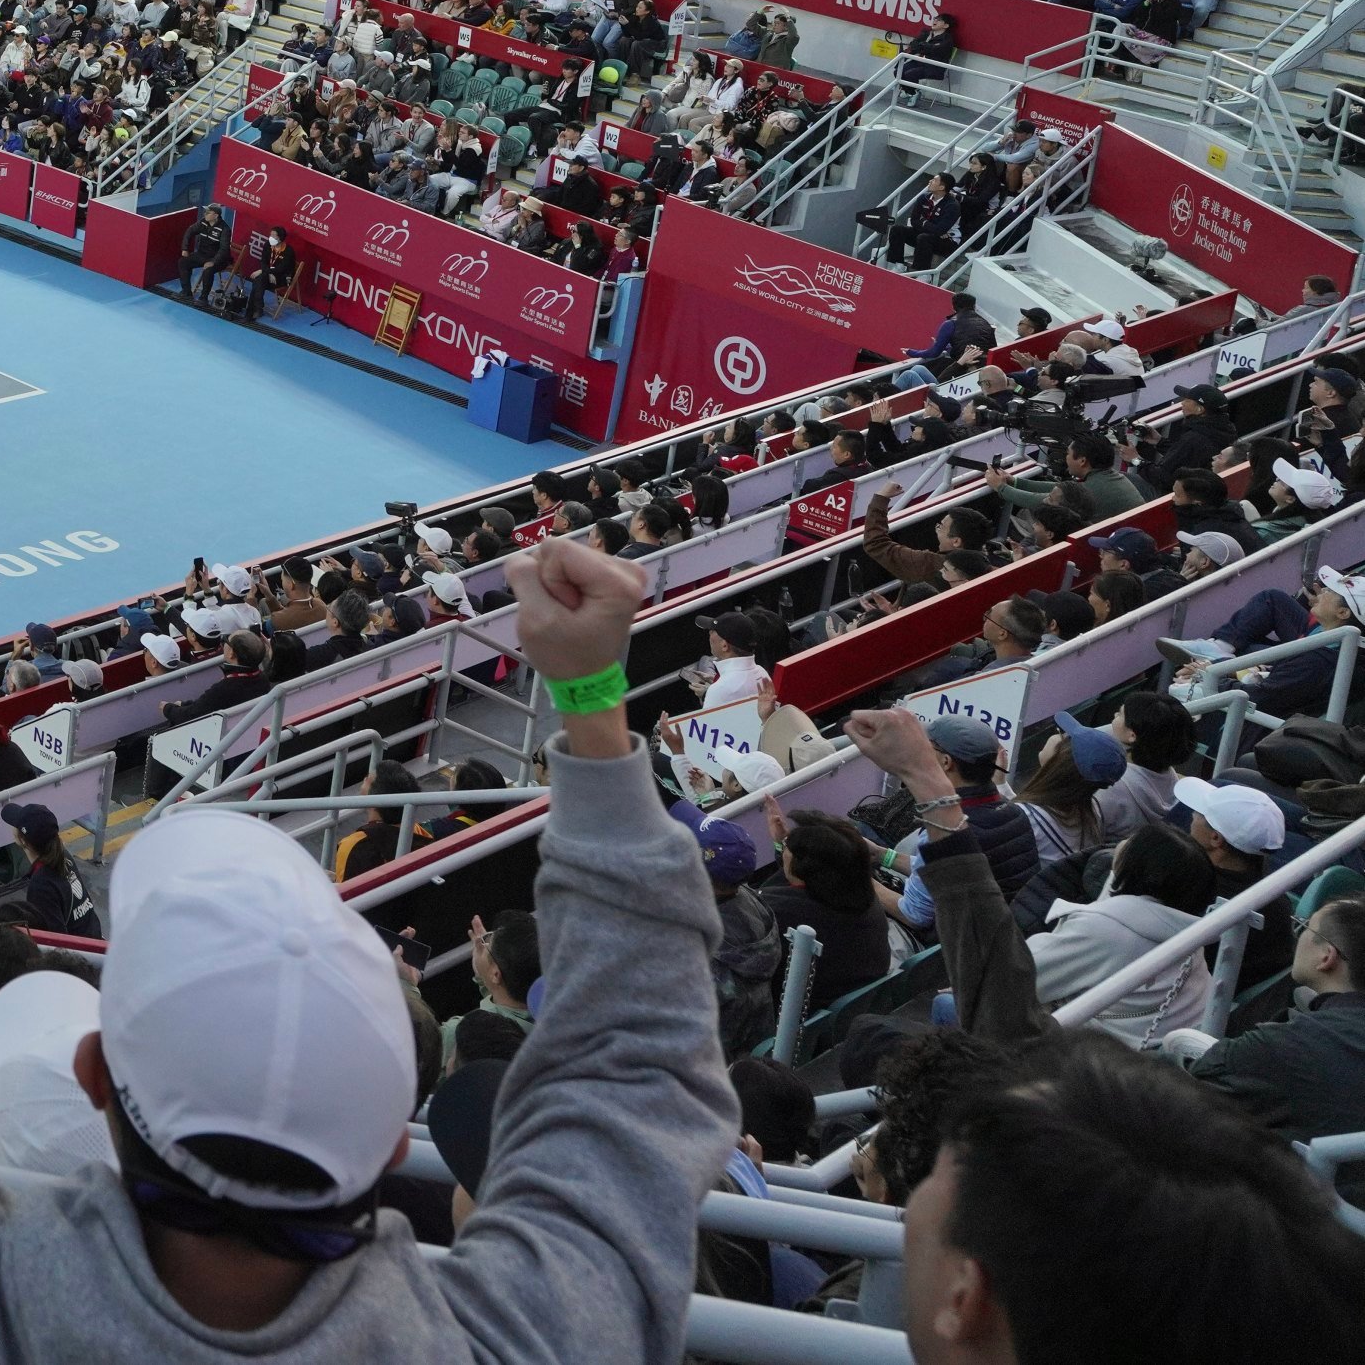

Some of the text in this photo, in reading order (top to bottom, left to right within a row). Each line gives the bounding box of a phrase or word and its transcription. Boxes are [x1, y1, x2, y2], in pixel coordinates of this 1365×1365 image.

[460, 31, 470, 42] W5
[506, 46, 548, 65] Skywalker Group
[1037, 113, 1084, 133] BANK OF CHINA
[606, 131, 618, 143] W2
[226, 190, 261, 209] Major Sports Events
[1200, 194, 1253, 234] 香港賽馬會
[1198, 211, 1247, 254] The Hong Kong
[1192, 230, 1233, 263] Jockey Club
[815, 269, 852, 292] KONG
[817, 261, 854, 283] HONG
[733, 281, 852, 329] ASIA'S WORLD CITY 亞洲國際都會
[824, 494, 847, 511] A2
[33, 727, 63, 755] N3B
[39, 749, 63, 767] TONY KO
[173, 749, 195, 766] CHUNG
